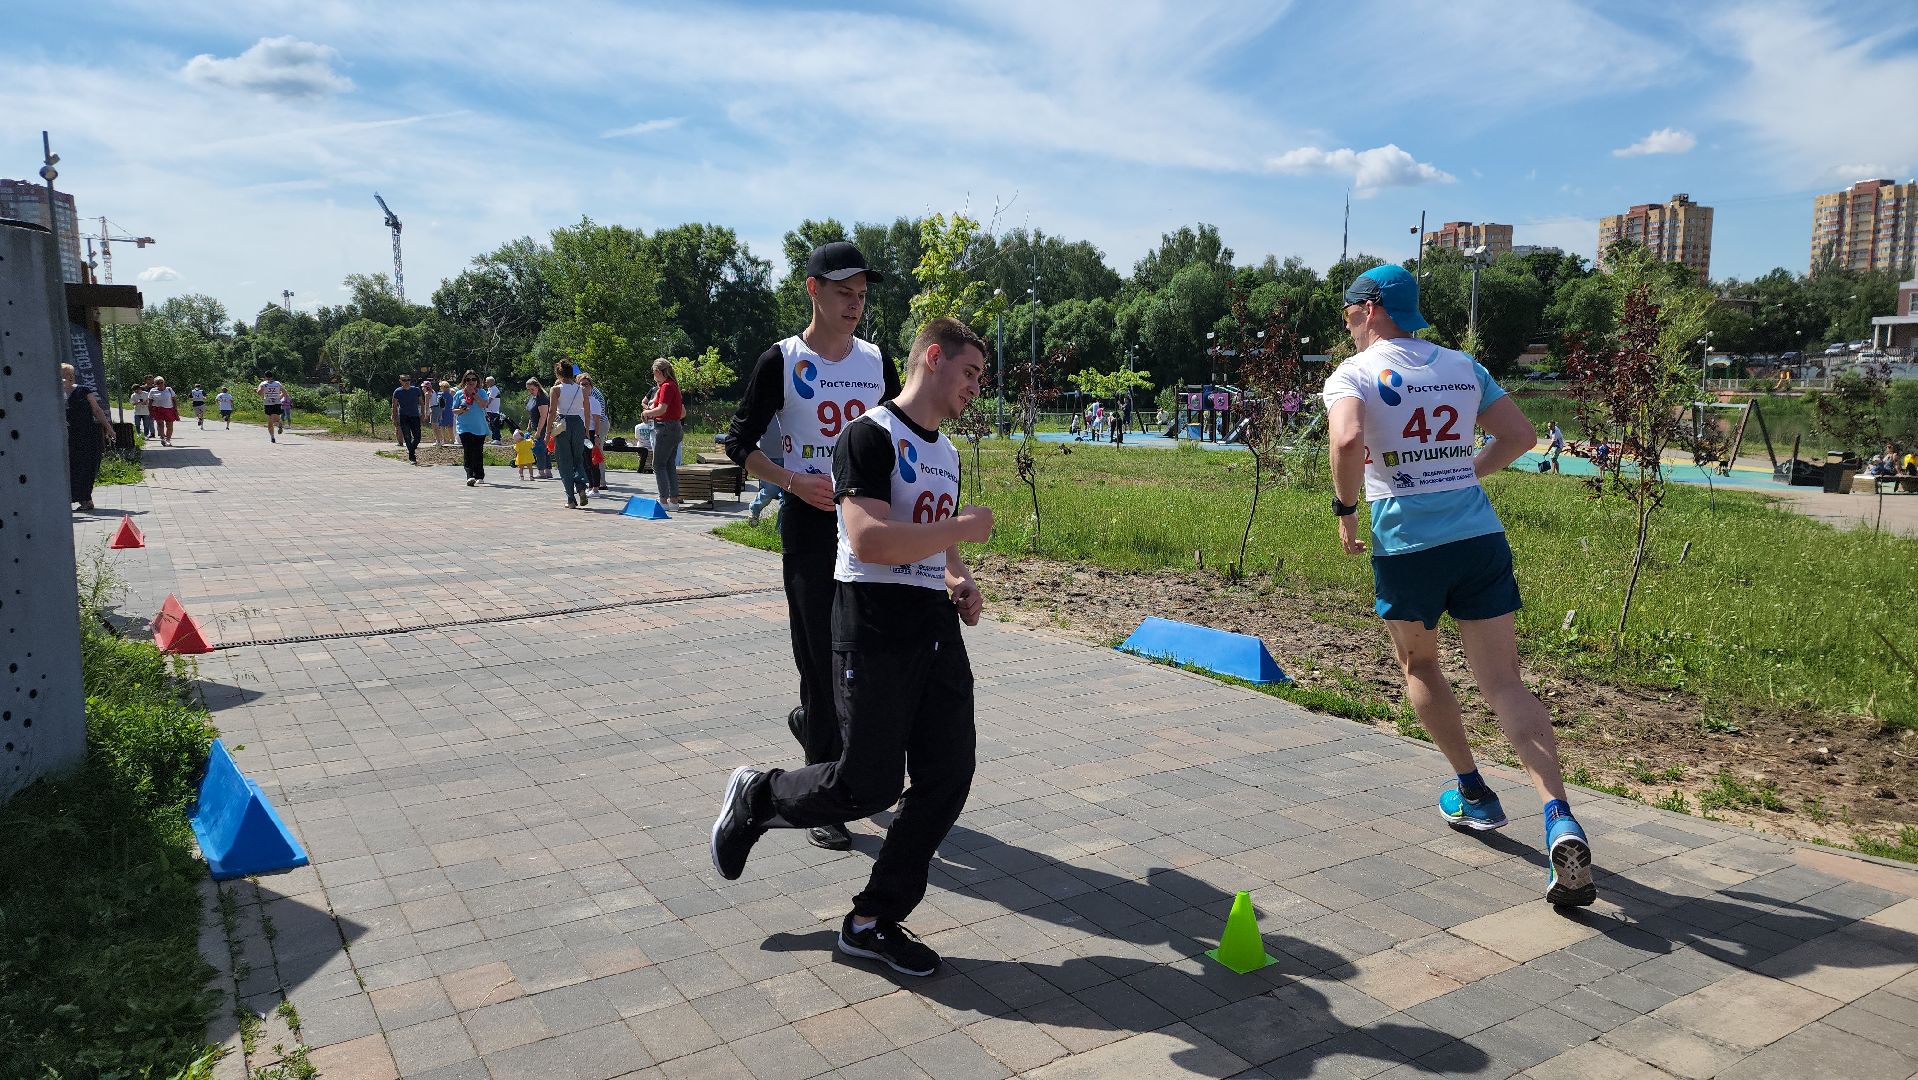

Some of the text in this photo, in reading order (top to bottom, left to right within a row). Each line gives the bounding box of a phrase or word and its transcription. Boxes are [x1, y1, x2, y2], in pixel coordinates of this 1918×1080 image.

[820, 379, 880, 391] Ростелеком
[1406, 383, 1476, 394] Ростелеком
[816, 399, 866, 438] 99
[1402, 404, 1461, 444] 42
[782, 435, 793, 454] 9
[1364, 445, 1374, 465] 2
[1401, 445, 1473, 464] ПУШКИНО
[913, 490, 954, 524] 66
